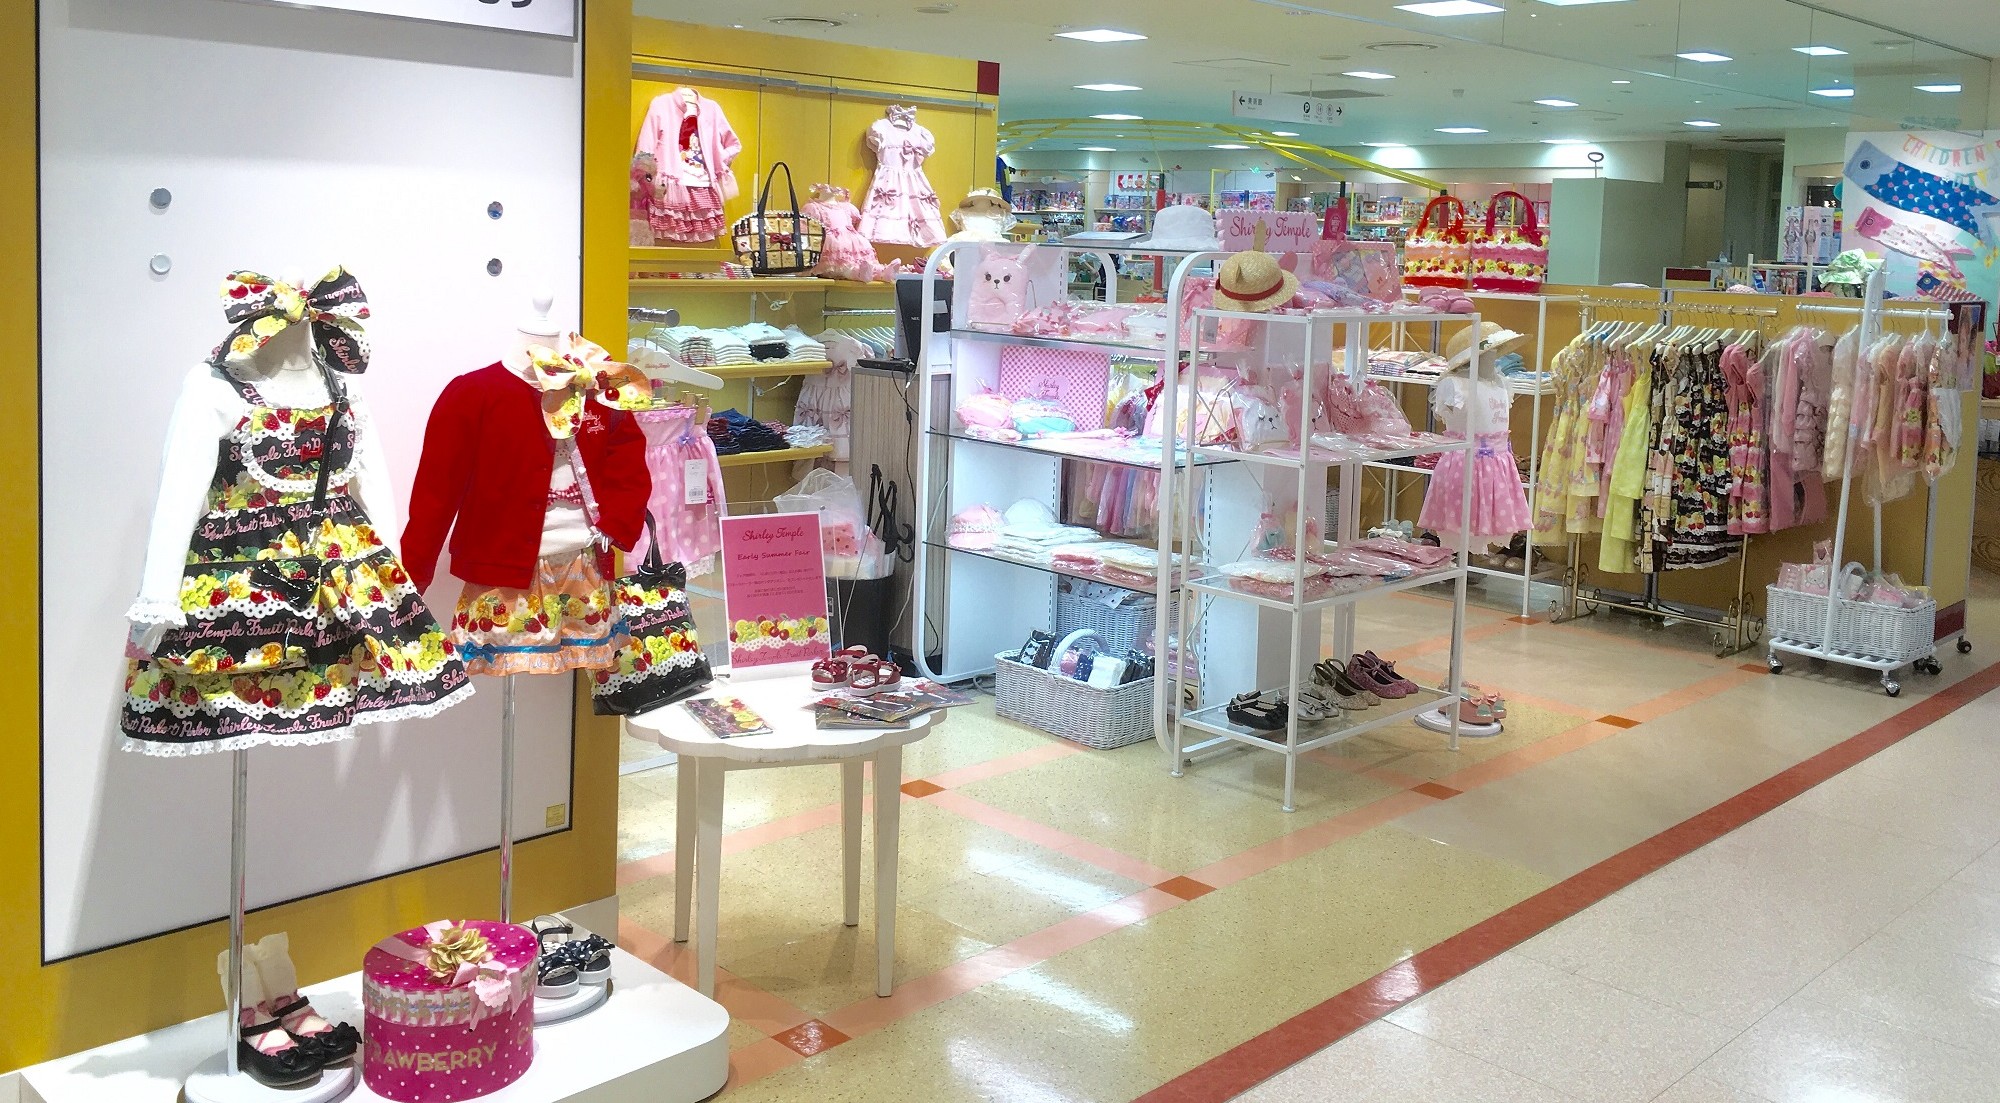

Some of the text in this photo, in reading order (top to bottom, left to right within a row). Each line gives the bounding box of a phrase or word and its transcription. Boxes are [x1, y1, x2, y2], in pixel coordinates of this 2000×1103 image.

[1230, 216, 1273, 245] Shiry
[1274, 217, 1311, 245] Temple
[742, 527, 804, 544] Shirley Temple
[761, 551, 792, 559] Summer
[388, 600, 426, 628] Temple
[197, 619, 245, 644] Temple
[246, 618, 285, 636] Fruit
[216, 713, 264, 734] Shirley
[306, 711, 344, 729] Fruit
